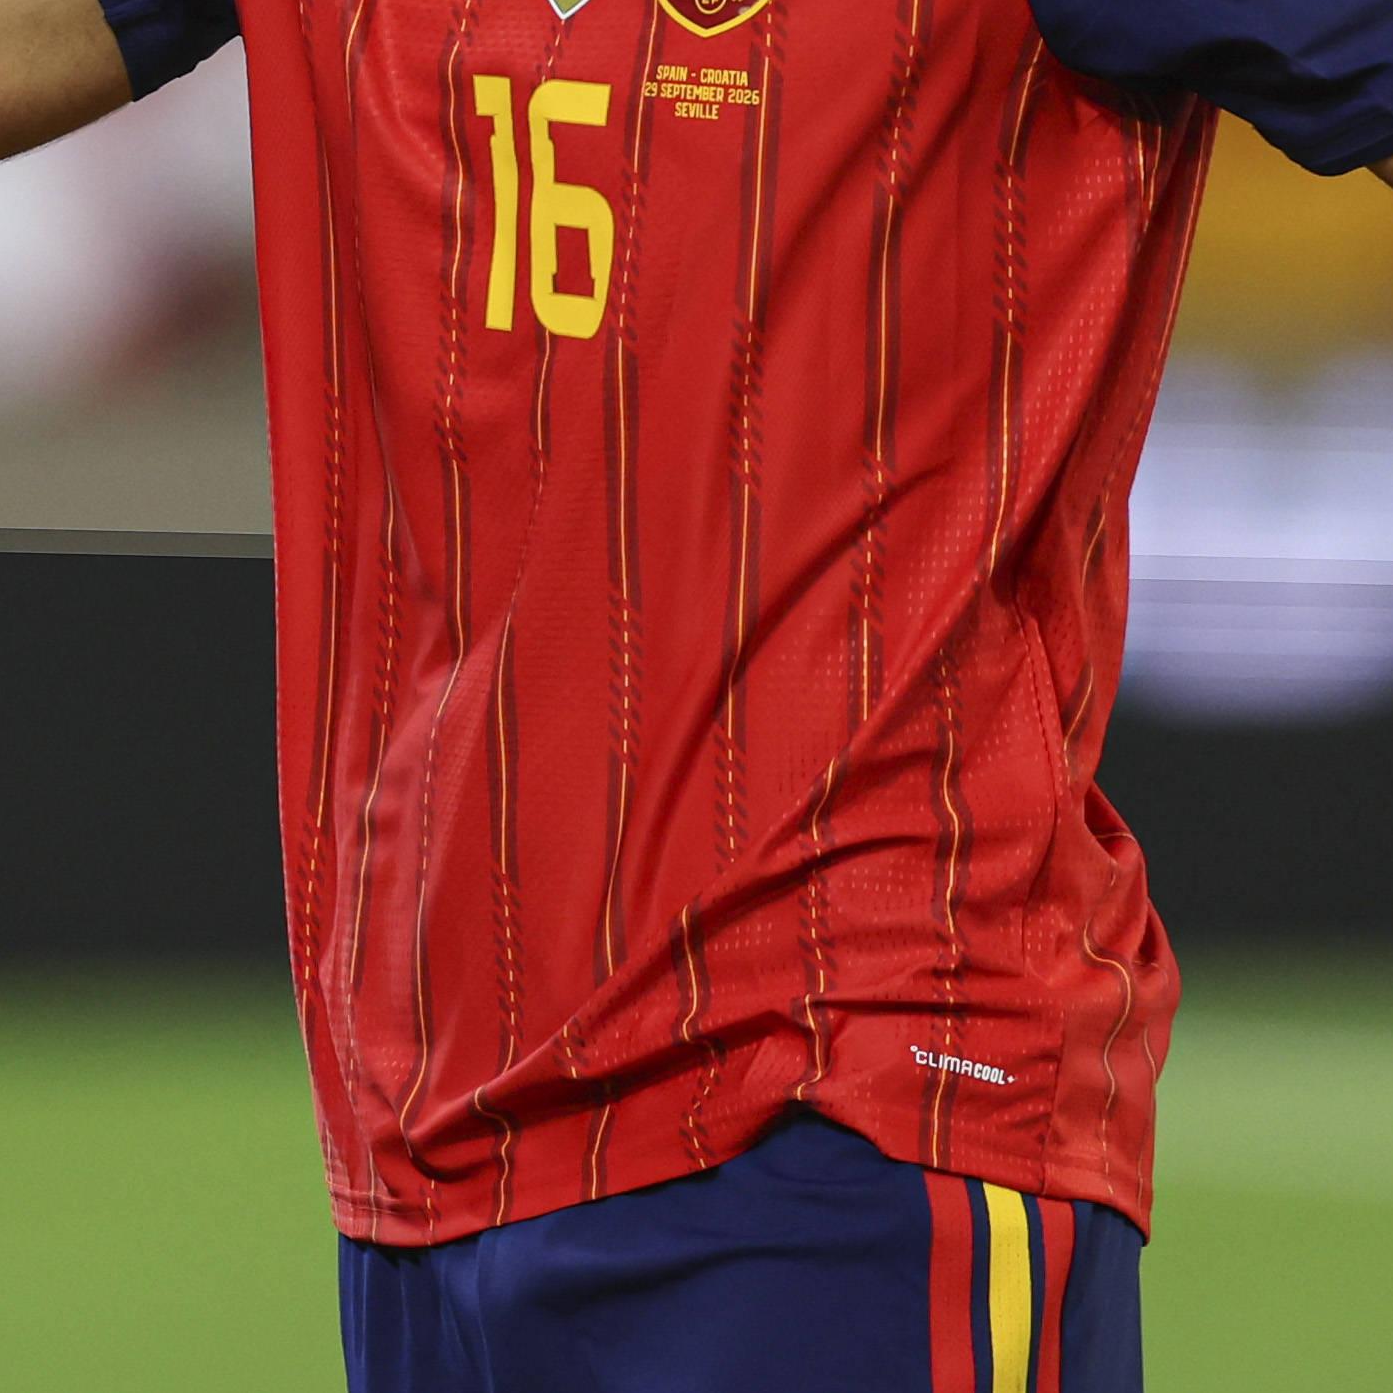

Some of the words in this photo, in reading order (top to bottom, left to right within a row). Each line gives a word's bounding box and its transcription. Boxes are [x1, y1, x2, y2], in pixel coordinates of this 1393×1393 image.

[656, 65, 688, 81] SPAIN
[700, 68, 748, 87] CROATIA
[644, 82, 658, 97] 29
[660, 83, 724, 102] SEPTEMBER
[727, 88, 760, 105] 2026
[674, 102, 719, 119] SEVILLE
[473, 74, 614, 339] 16
